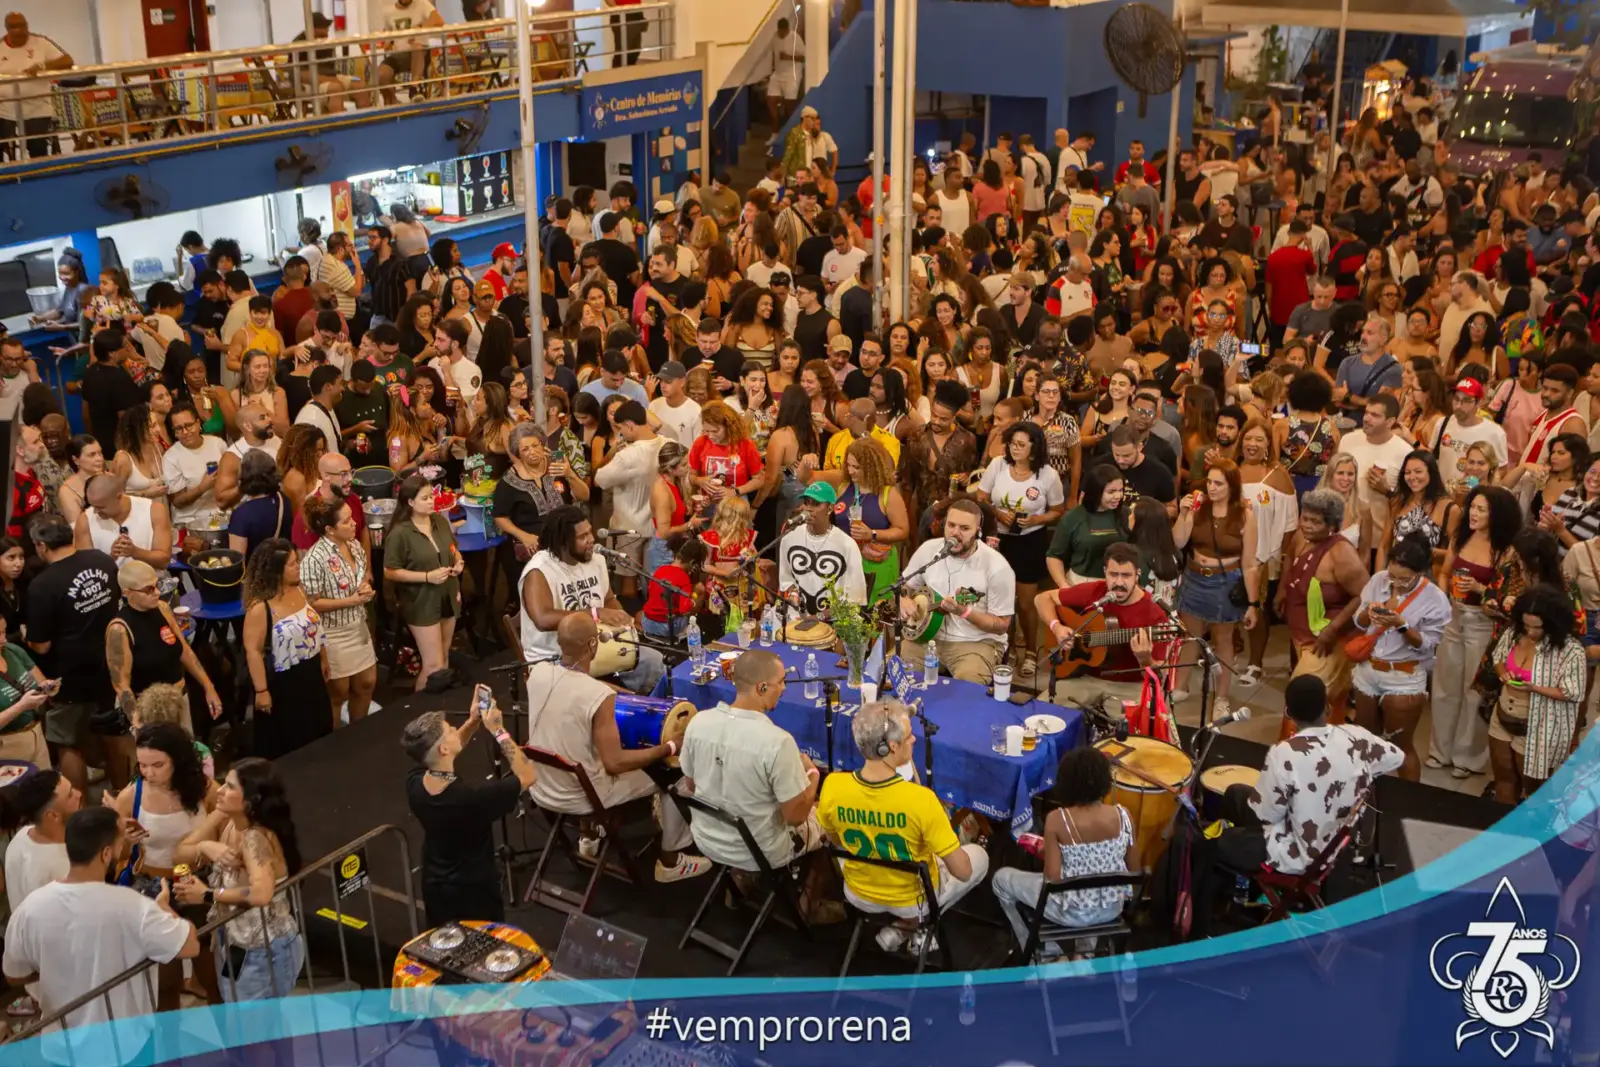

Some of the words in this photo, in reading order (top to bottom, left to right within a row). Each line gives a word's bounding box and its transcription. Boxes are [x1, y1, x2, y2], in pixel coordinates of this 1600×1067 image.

[610, 97, 636, 112] Centro
[637, 93, 646, 107] de
[647, 88, 681, 105] Memórias
[68, 569, 108, 598] MATILHA
[81, 582, 101, 597] 1907
[837, 805, 907, 828] RONALDO
